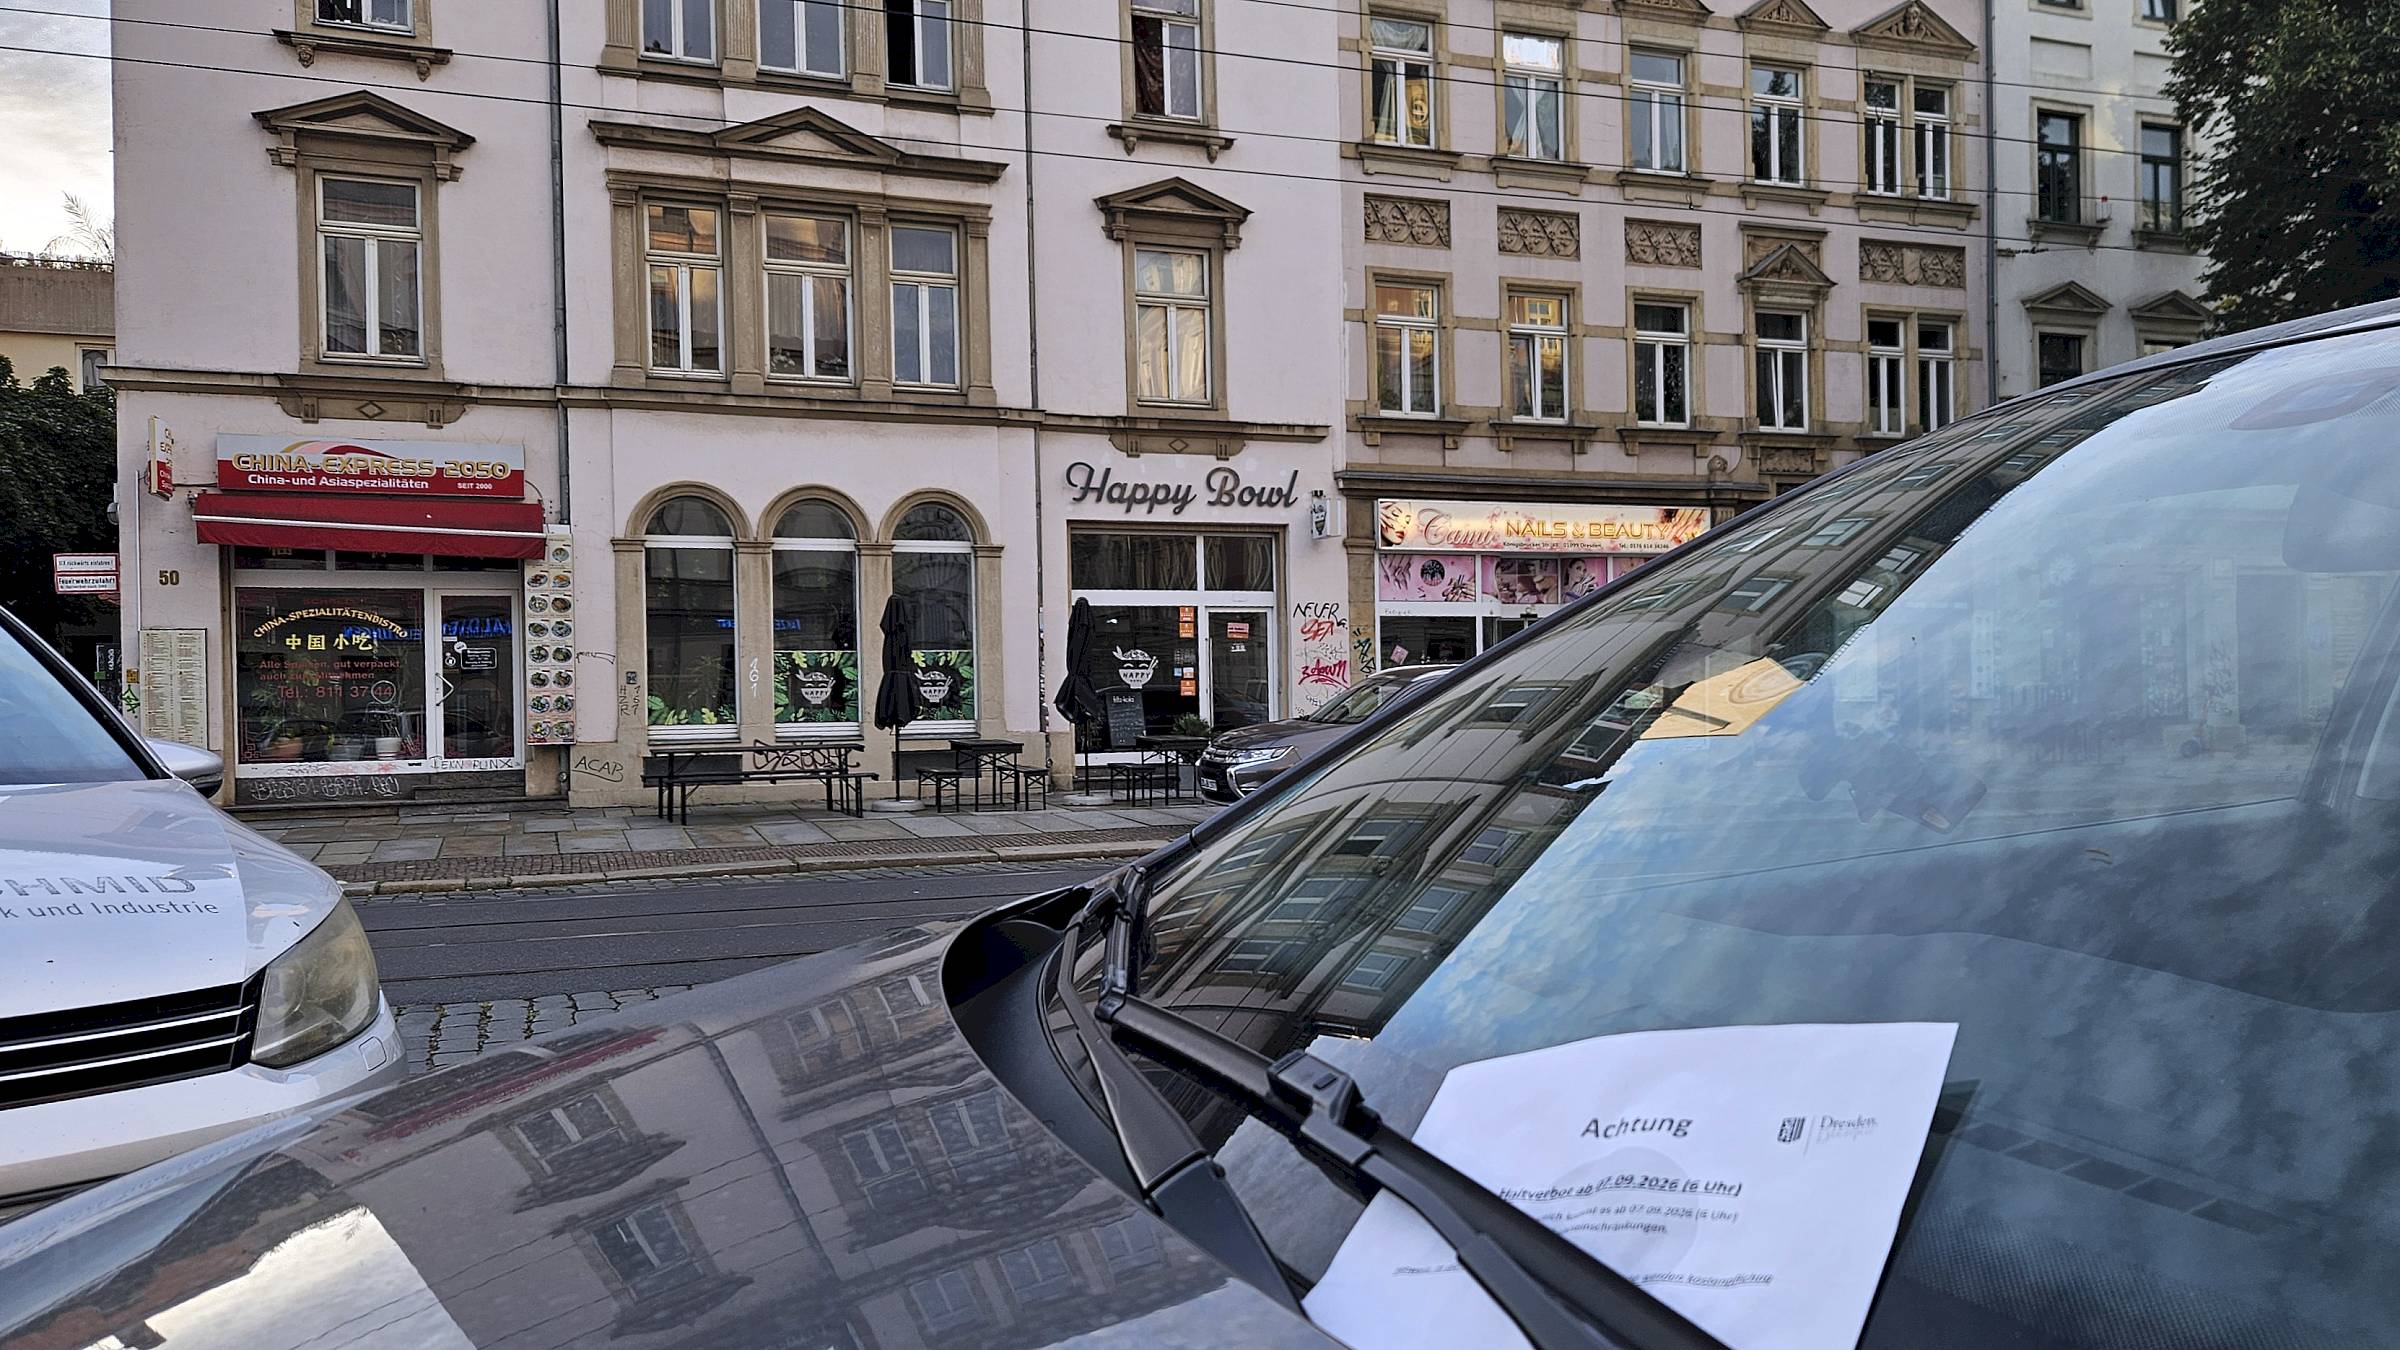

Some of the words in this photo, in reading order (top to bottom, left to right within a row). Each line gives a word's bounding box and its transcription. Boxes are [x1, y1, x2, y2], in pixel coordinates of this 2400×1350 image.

[231, 452, 436, 477] CHINA-EXPRESS
[443, 460, 511, 479] 2050
[319, 476, 429, 489] Asiaspezialitäten
[1065, 462, 1198, 515] Happy
[1206, 466, 1299, 509] Bowl
[1506, 520, 1567, 538] NAILS
[1572, 521, 1585, 538] &
[1589, 521, 1669, 540] BEAUTY
[159, 570, 179, 585] 50
[253, 607, 408, 638] CHINA-SPEZIALITÄTENBISTRO
[333, 661, 351, 670] gut
[354, 660, 400, 670] verpackt
[278, 686, 309, 698] Tel.:
[350, 686, 369, 698] 37
[374, 686, 393, 698] 44
[574, 756, 624, 780] ACAB
[0, 877, 196, 896] HMID
[27, 903, 84, 917] und
[91, 901, 220, 915] Industrie
[1581, 1117, 1694, 1139] Achtung
[1704, 1181, 1742, 1196] Uhr)
